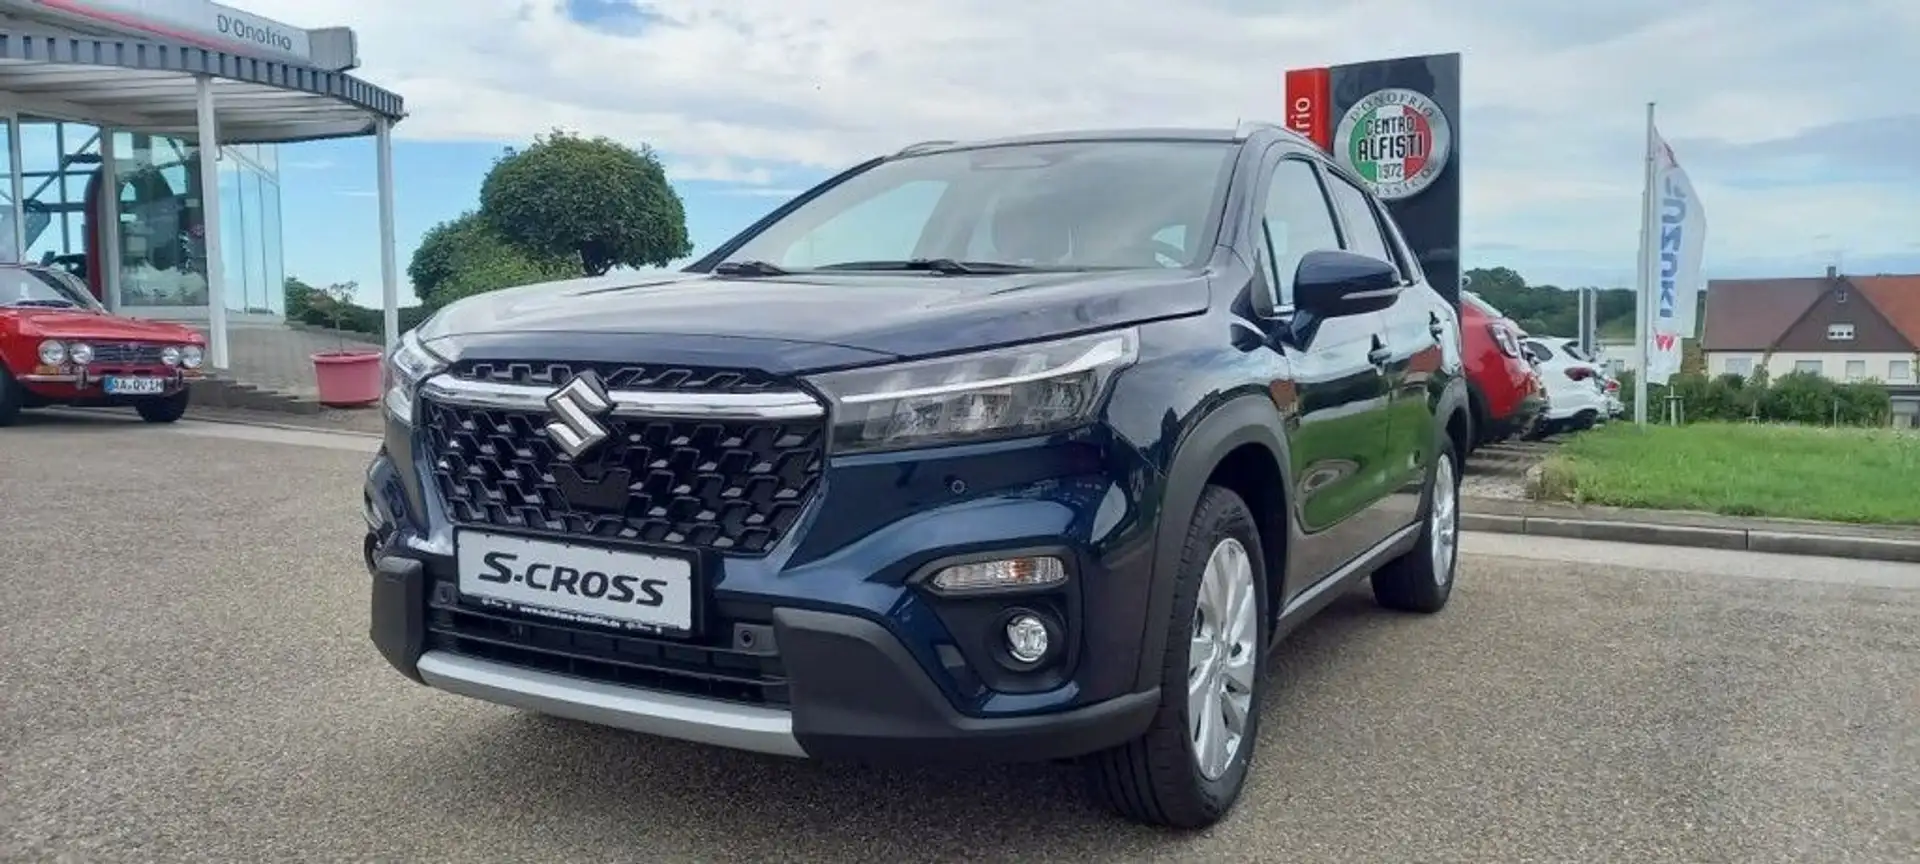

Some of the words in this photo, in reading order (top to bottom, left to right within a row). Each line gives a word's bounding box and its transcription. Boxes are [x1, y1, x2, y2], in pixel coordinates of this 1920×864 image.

[217, 13, 292, 50] D'Onofrio
[1290, 97, 1310, 136] rio
[1366, 116, 1415, 136] CENTRO
[1358, 134, 1423, 161] ALFISTI
[1377, 162, 1402, 179] 1972
